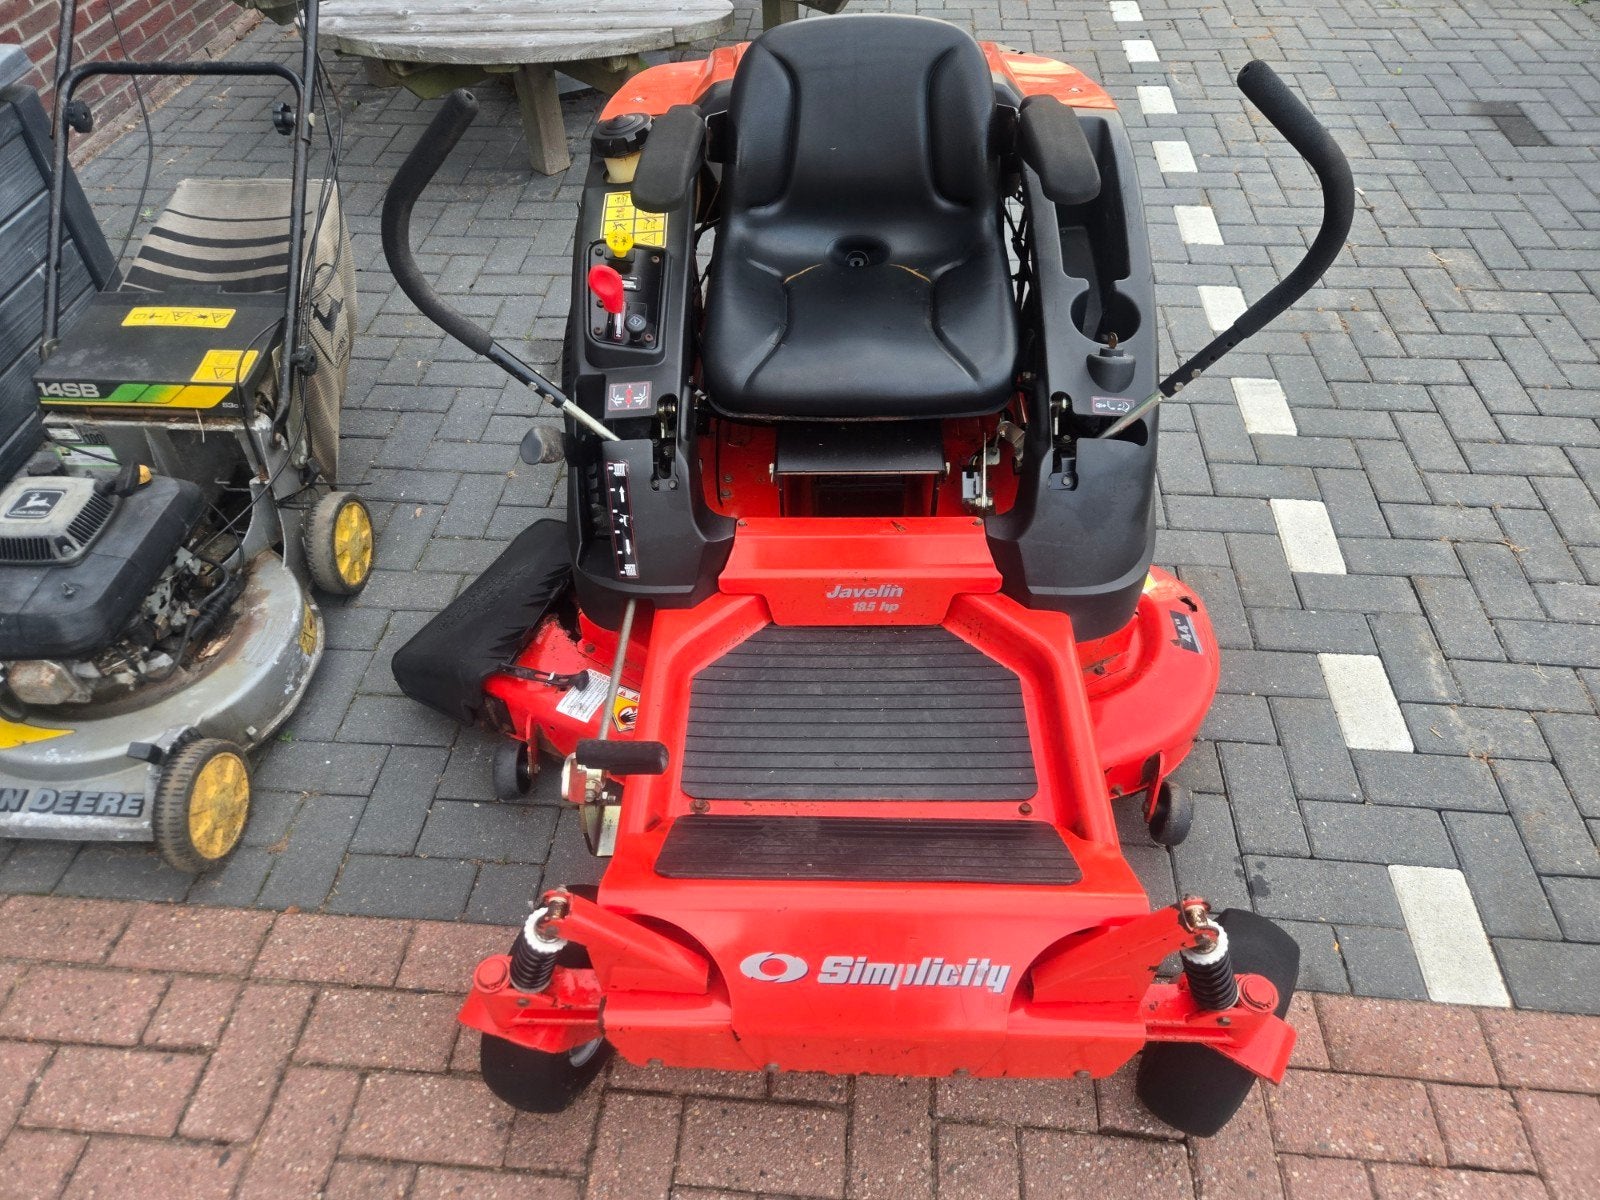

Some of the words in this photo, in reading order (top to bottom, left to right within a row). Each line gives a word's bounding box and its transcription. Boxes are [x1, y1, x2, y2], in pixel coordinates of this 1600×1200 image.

[37, 382, 100, 398] 14SB
[826, 585, 903, 599] Javelin
[879, 601, 900, 613] hp
[28, 787, 145, 817] DEERE
[816, 956, 1011, 993] Simplicity
